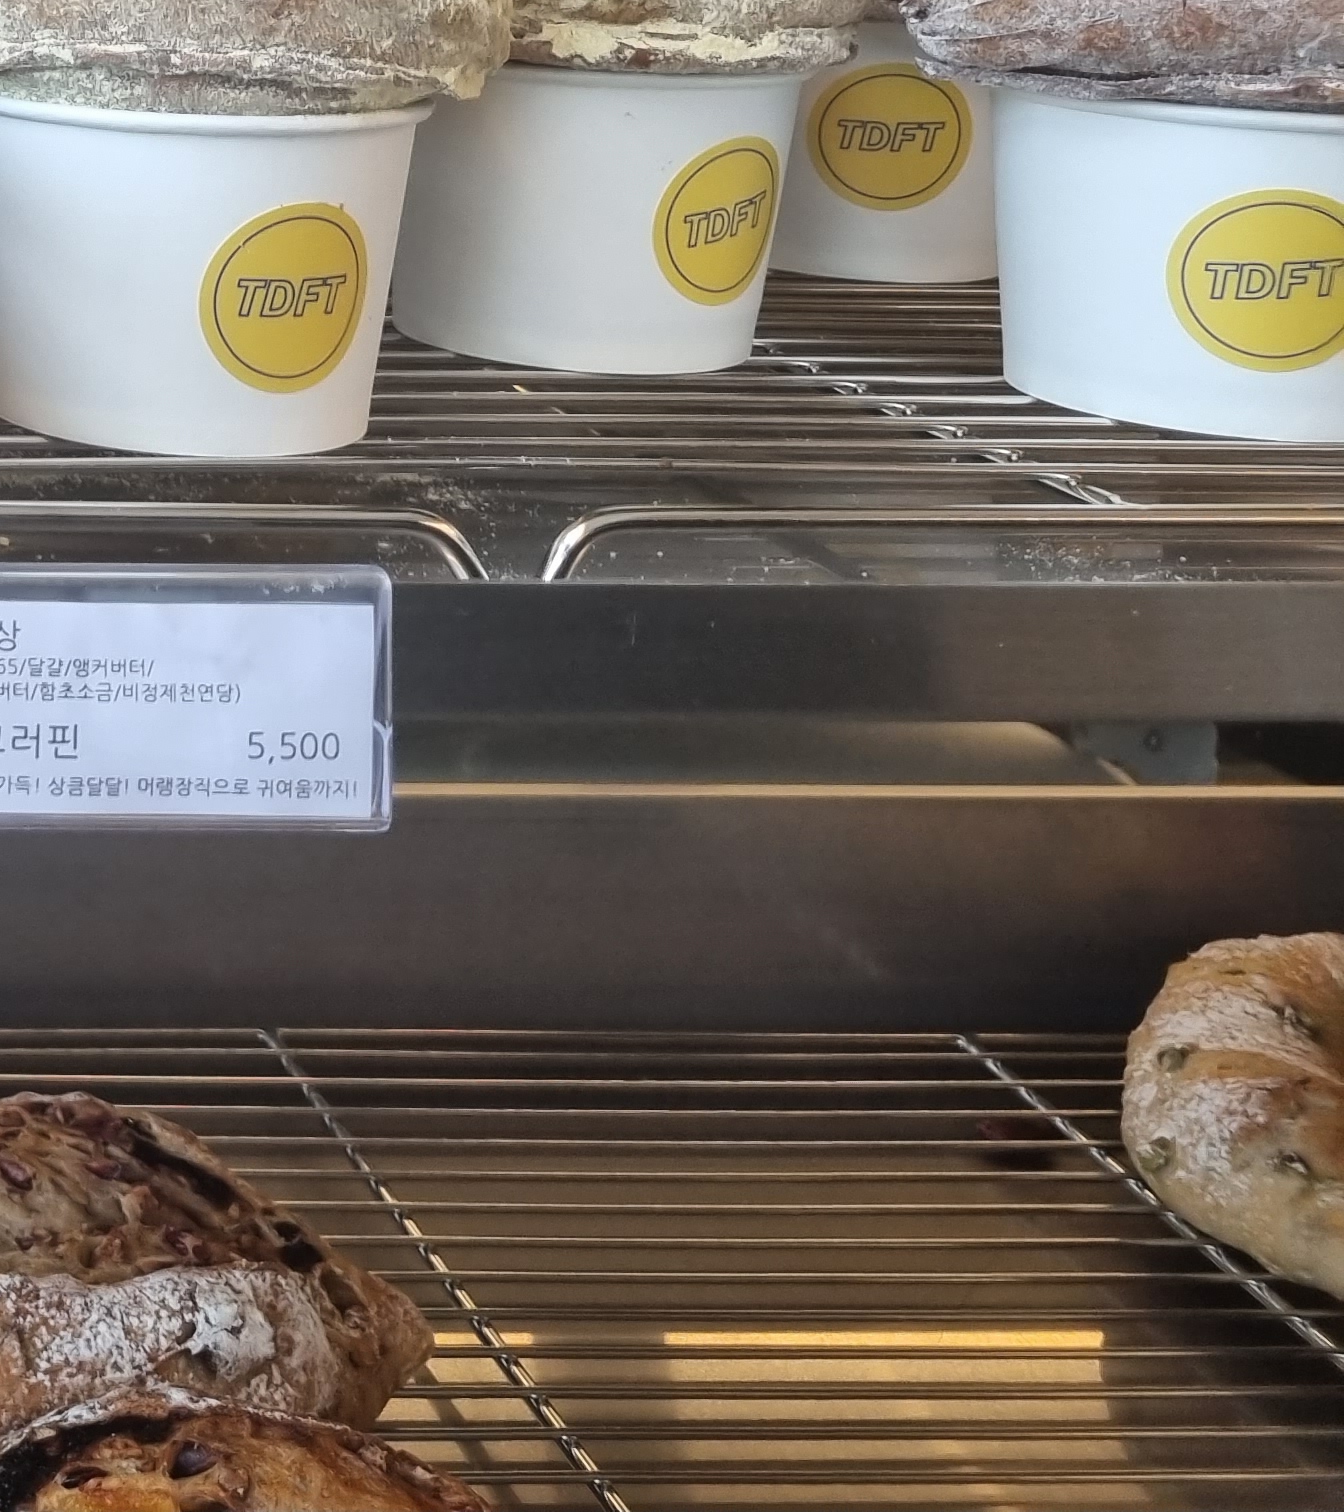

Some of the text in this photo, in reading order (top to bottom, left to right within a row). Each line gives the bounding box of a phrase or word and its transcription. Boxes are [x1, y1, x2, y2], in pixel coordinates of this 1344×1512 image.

[836, 118, 946, 153] TDFT
[683, 189, 768, 248] TDFT
[236, 273, 347, 318] TDFT
[1204, 258, 1344, 300] TDFT
[246, 731, 341, 765] 5,500
[48, 776, 130, 798] 상큼달달!
[257, 778, 358, 801] 귀여움까지!
